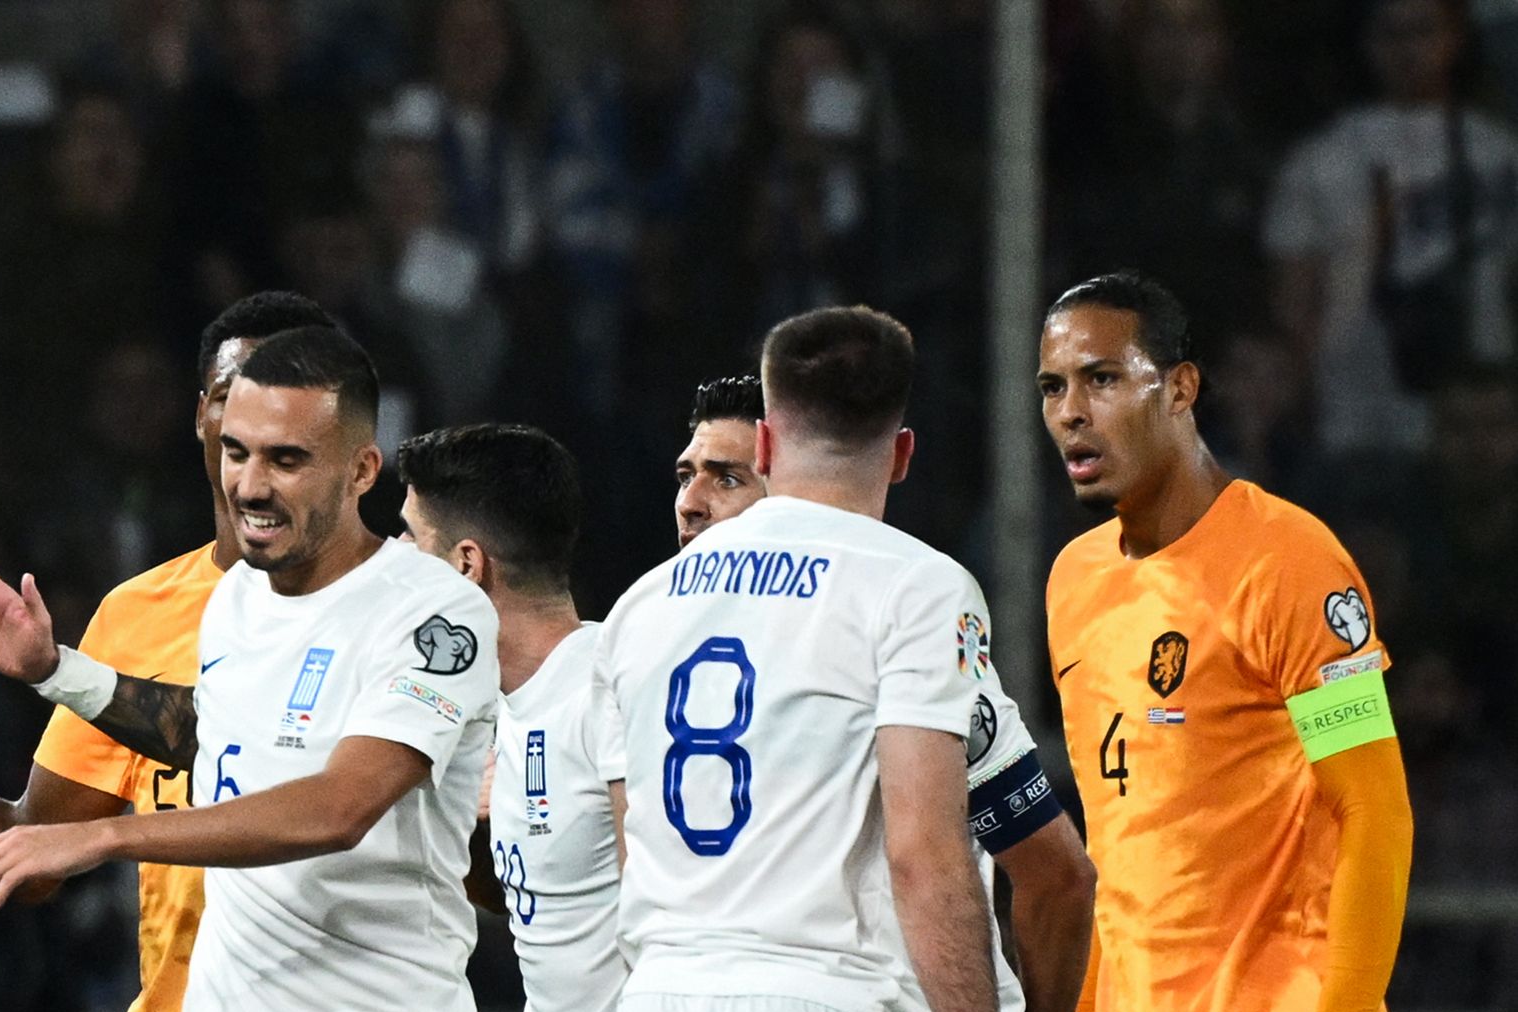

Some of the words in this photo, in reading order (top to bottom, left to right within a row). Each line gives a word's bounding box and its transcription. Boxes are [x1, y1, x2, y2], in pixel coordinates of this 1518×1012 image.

[668, 550, 830, 599] IOANNIDIS
[1313, 698, 1379, 730] RESPECT
[662, 636, 756, 857] 8
[1099, 712, 1128, 797] 4
[969, 811, 998, 833] PECT
